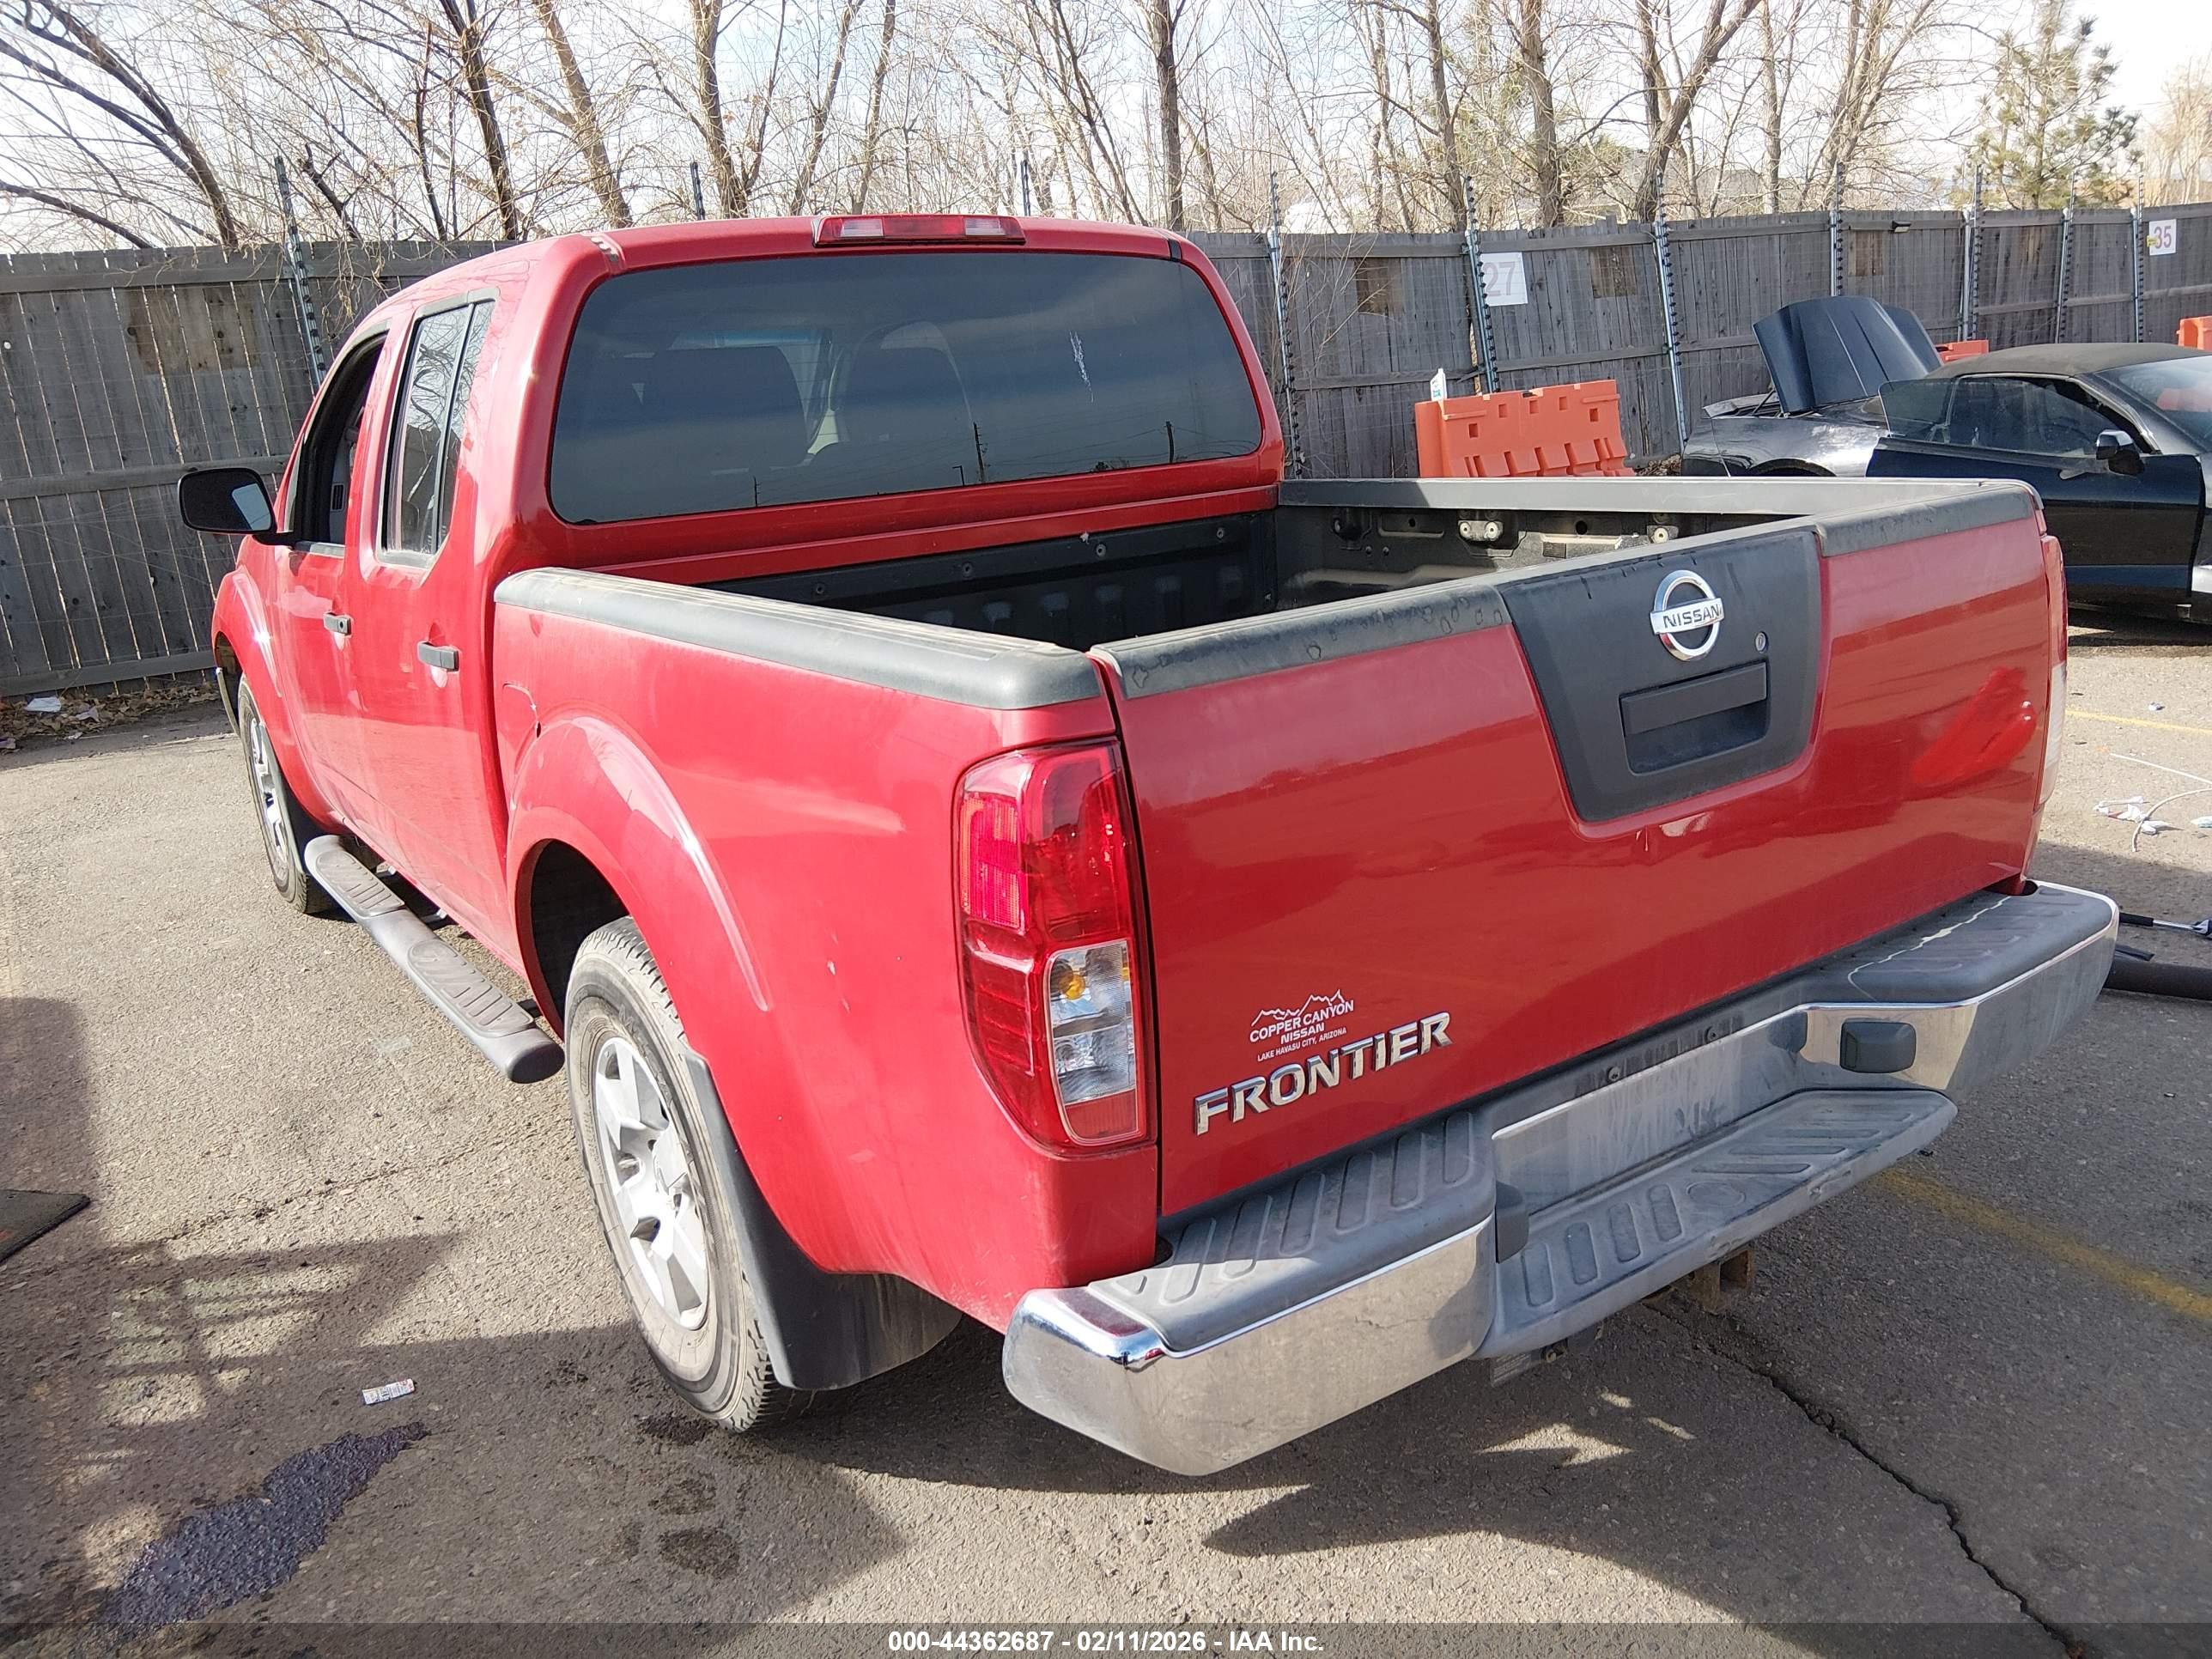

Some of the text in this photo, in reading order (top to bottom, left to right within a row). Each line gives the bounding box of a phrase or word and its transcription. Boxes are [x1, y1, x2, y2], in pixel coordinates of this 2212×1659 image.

[2154, 225, 2172, 249] 35
[1483, 261, 1516, 297] 27
[1663, 604, 1722, 629] NISSAN
[1249, 1000, 1354, 1042] COPPER CANYON
[1280, 1022, 1325, 1044] NISSAN
[1257, 1049, 1275, 1062] LAKE
[1302, 1036, 1317, 1048] CITY,
[1319, 1027, 1347, 1042] ARIZONA
[1194, 1011, 1453, 1136] FRONTIER
